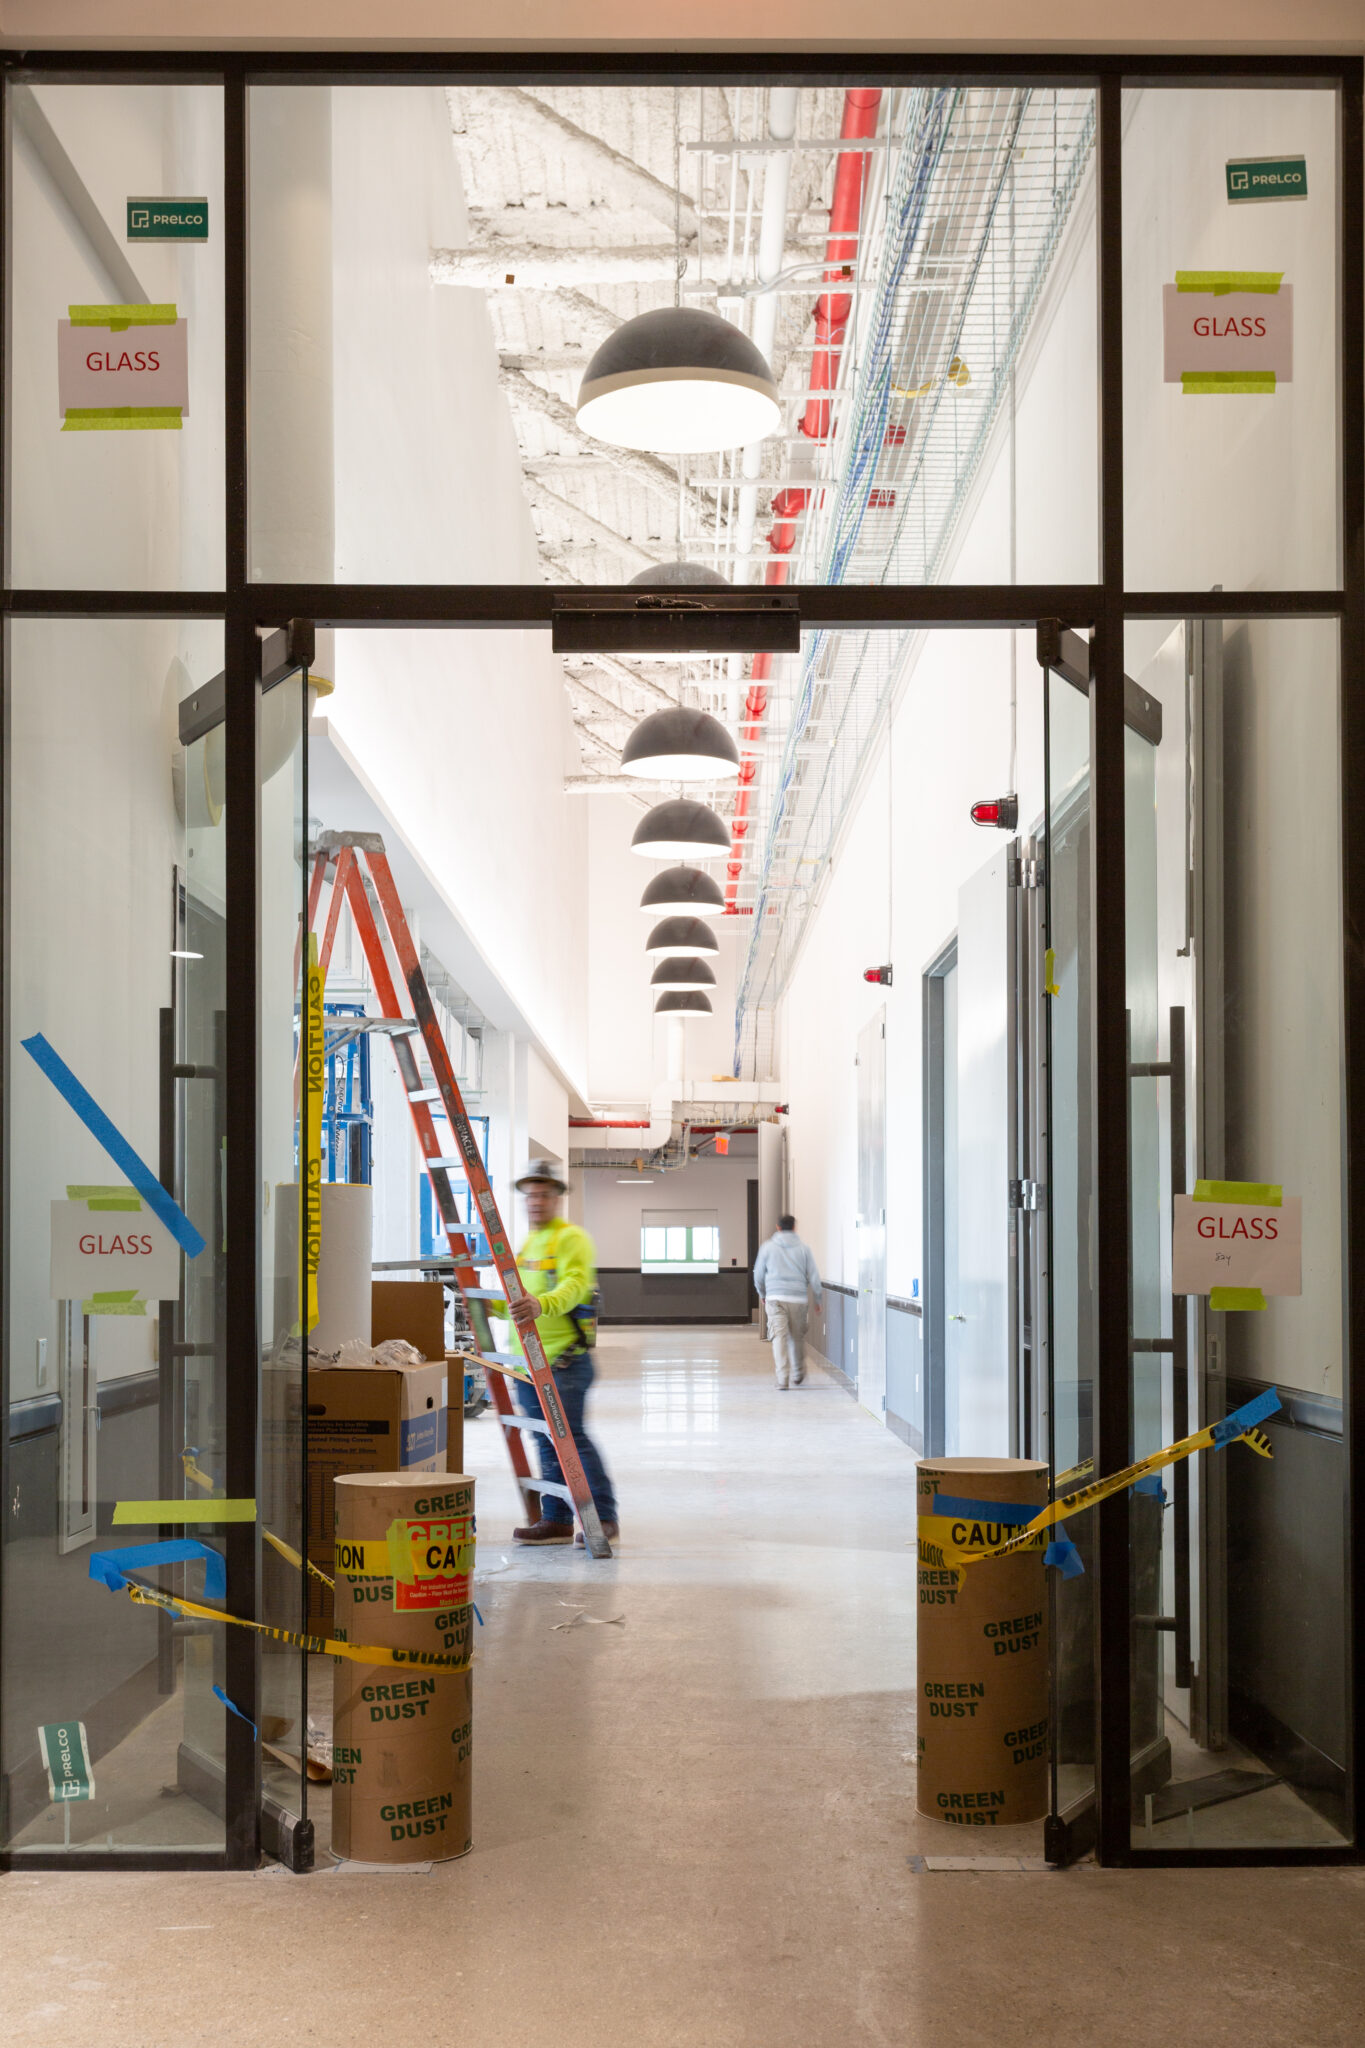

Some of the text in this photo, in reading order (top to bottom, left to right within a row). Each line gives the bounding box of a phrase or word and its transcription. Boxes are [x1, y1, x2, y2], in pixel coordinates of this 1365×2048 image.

[1193, 317, 1266, 337] GLASS
[86, 351, 160, 372] GLASS
[1197, 1216, 1279, 1240] GLASS
[79, 1234, 153, 1255] GLASS
[546, 1390, 566, 1438] LOUISVILLE
[918, 1480, 940, 1495] UST
[414, 1487, 472, 1515] GREEN
[353, 1585, 394, 1603] DUS
[920, 1589, 958, 1604] DUST
[983, 1611, 1043, 1638] GREEN
[994, 1631, 1040, 1656] DUST
[361, 1678, 435, 1702] GREEN
[924, 1682, 985, 1698] GREEN
[370, 1700, 429, 1722] DUST
[929, 1702, 979, 1717] DUST
[380, 1792, 453, 1821] GREEN
[937, 1790, 1005, 1808] GREEN
[391, 1815, 448, 1841] DUST
[944, 1810, 999, 1826] DUST
